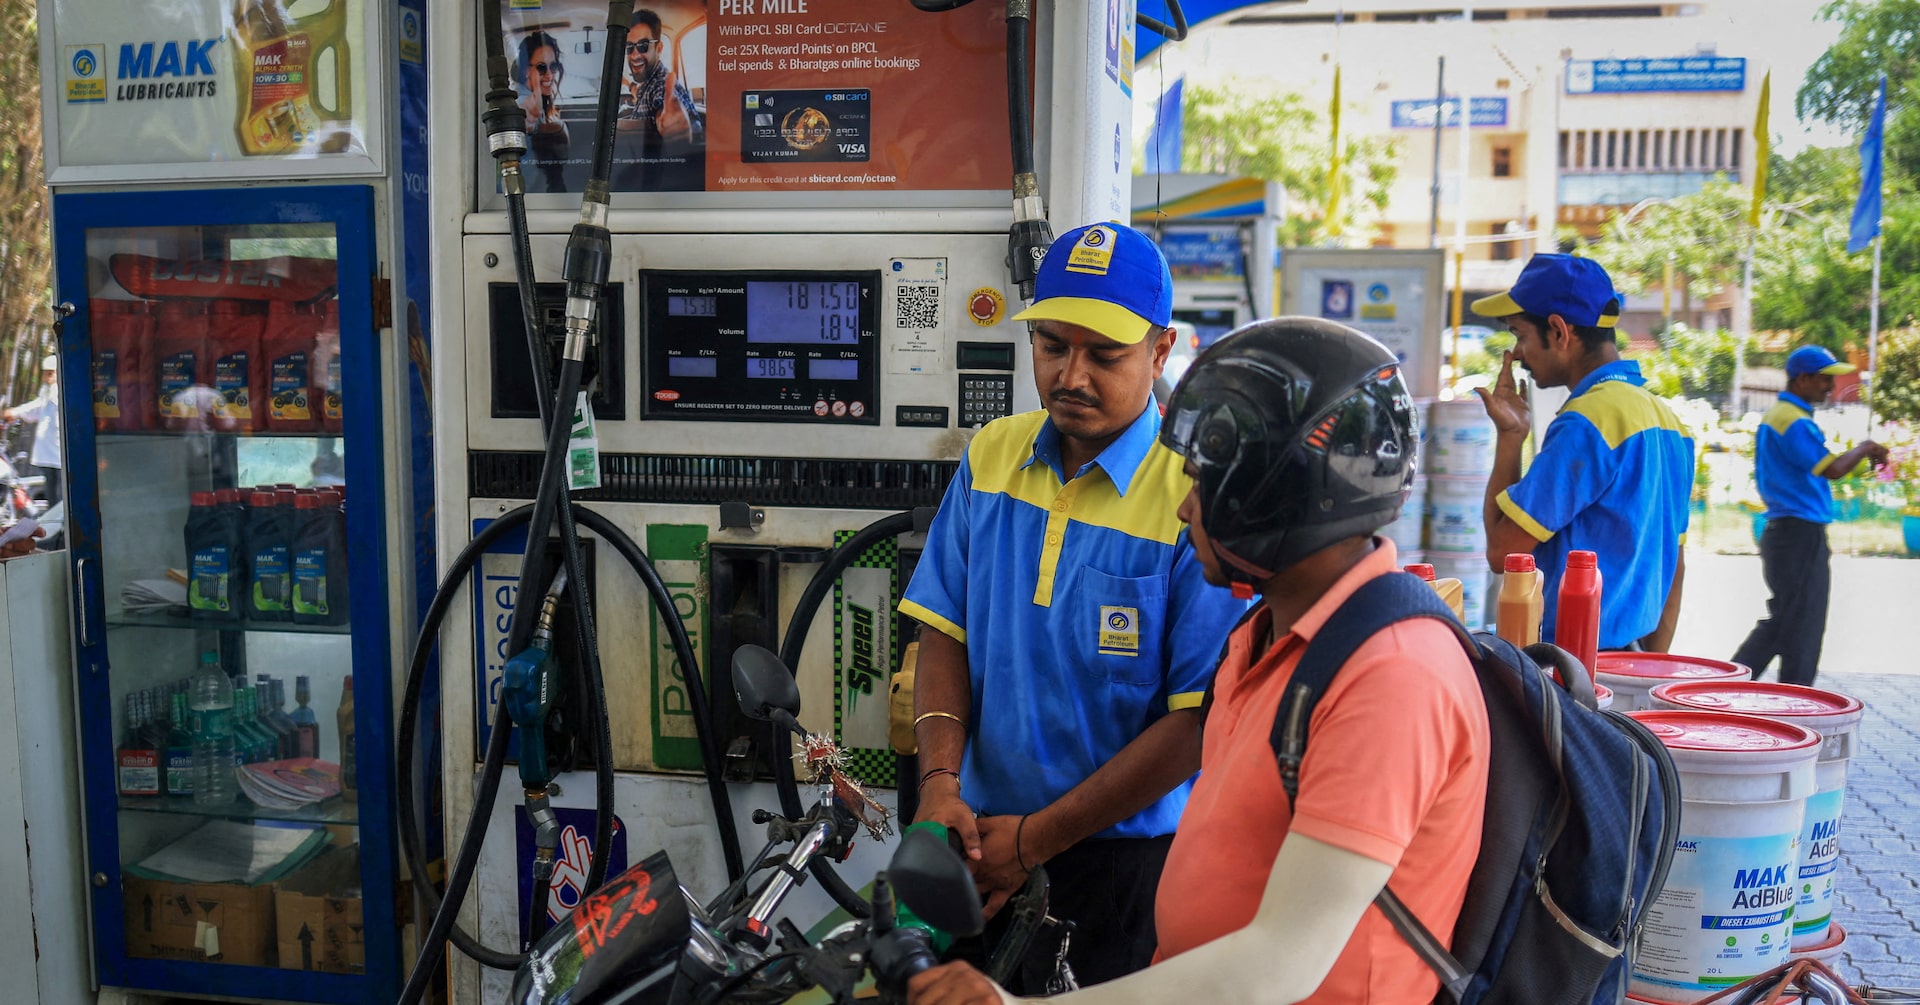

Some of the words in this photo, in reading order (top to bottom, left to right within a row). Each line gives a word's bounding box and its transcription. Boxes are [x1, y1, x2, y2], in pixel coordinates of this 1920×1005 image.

[720, 0, 754, 15] PER
[762, 0, 808, 14] MILE
[719, 26, 742, 35] With
[744, 24, 771, 35] BPCL
[775, 24, 792, 34] SBI
[796, 24, 821, 34] Card
[824, 22, 887, 33] OCTANE
[719, 46, 737, 56] Get
[740, 45, 759, 56] 25X
[762, 44, 798, 54] Reward
[836, 44, 848, 54] on
[852, 42, 877, 53] BPCL
[118, 40, 217, 80] MAK
[255, 55, 281, 65] MAK
[719, 60, 736, 70] fuel
[739, 60, 773, 73] spends
[778, 60, 787, 70] &
[790, 58, 839, 72] Bharatgas
[842, 57, 872, 68] online
[875, 57, 920, 71] bookings
[256, 74, 288, 83] 10W-30
[117, 80, 216, 100] LUBRICANTS
[846, 92, 868, 100] card
[837, 144, 866, 153] VISA
[718, 177, 737, 185] Apply
[809, 174, 896, 184] sbicard.com/octane
[1074, 256, 1104, 264] Petroleum
[1080, 250, 1100, 258] Bharat
[789, 284, 856, 310] 181.50
[821, 314, 856, 340] 1.84
[847, 602, 884, 696] Speed
[1734, 864, 1788, 889] MAK
[1732, 886, 1793, 910] AdBlue
[1720, 918, 1743, 927] DIESEL
[1744, 915, 1769, 926] EXHAUST
